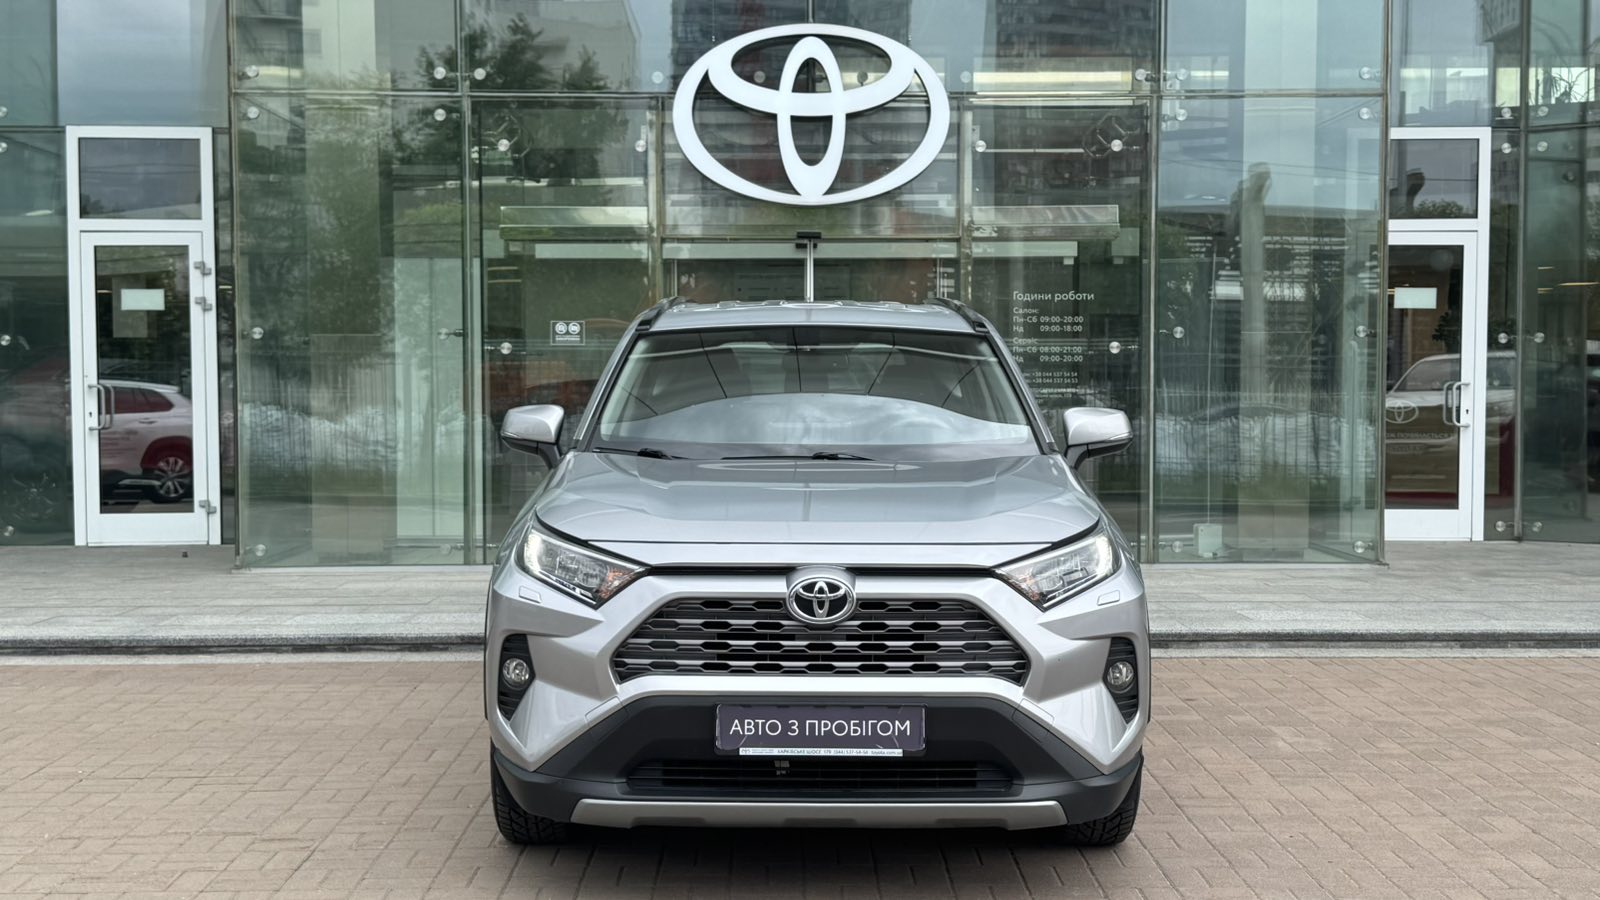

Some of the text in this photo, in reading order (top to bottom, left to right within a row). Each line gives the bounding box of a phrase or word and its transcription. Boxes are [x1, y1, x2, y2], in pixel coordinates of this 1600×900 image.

[1013, 291, 1095, 302] Години роботи
[1013, 325, 1024, 333] Нд
[730, 719, 911, 736] АВТО З ПРОБІГОМ
